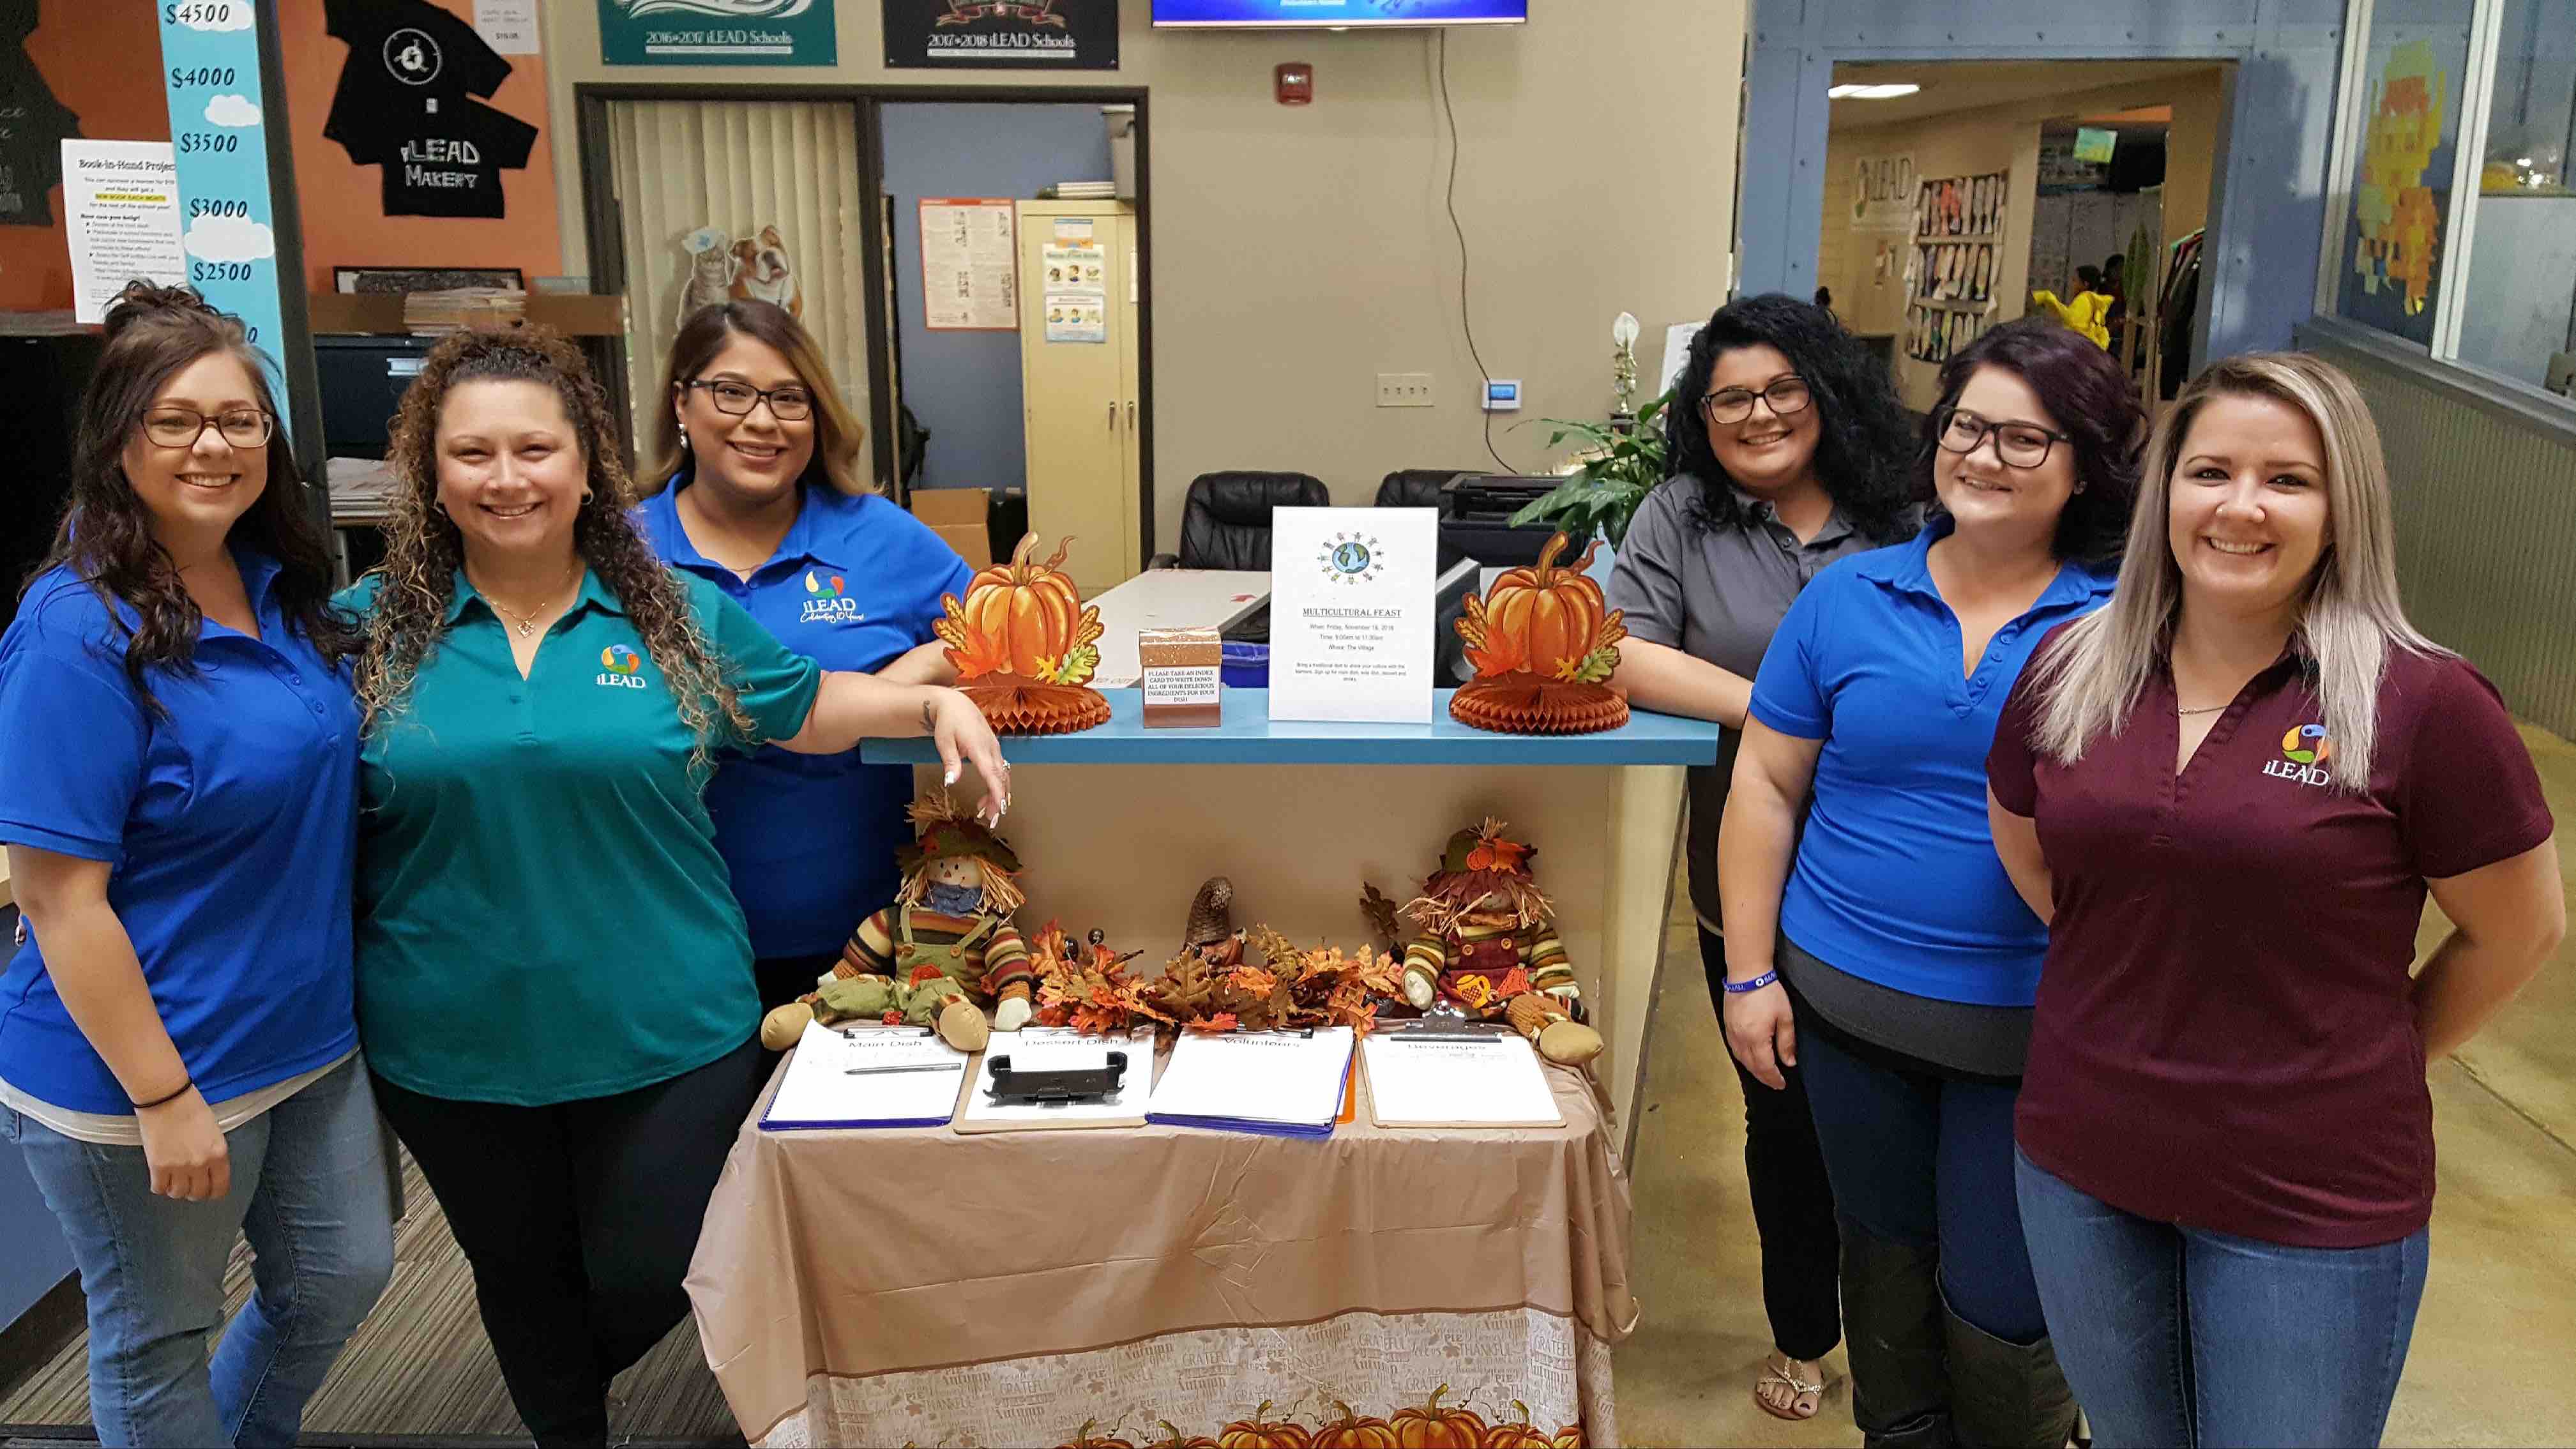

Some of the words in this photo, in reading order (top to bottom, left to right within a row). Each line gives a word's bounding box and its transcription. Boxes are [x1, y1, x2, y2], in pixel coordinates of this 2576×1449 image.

[165, 4, 230, 25] $4500
[706, 30, 746, 43] iLEAD
[749, 31, 792, 44] Schools
[989, 33, 1031, 47] iLEAD
[1032, 33, 1075, 47] Schools
[172, 68, 234, 88] $4000
[180, 133, 237, 153] $3500
[145, 161, 176, 173] Projec
[190, 198, 247, 218] $3000
[193, 262, 252, 281] $2500
[803, 598, 856, 613] iLEAD
[1303, 608, 1372, 617] MULTICULTURAL
[1374, 609, 1402, 617] FEAST
[597, 674, 646, 688] iLEAD
[2262, 760, 2330, 786] iLEAD
[1224, 1037, 1300, 1047] Volunteers
